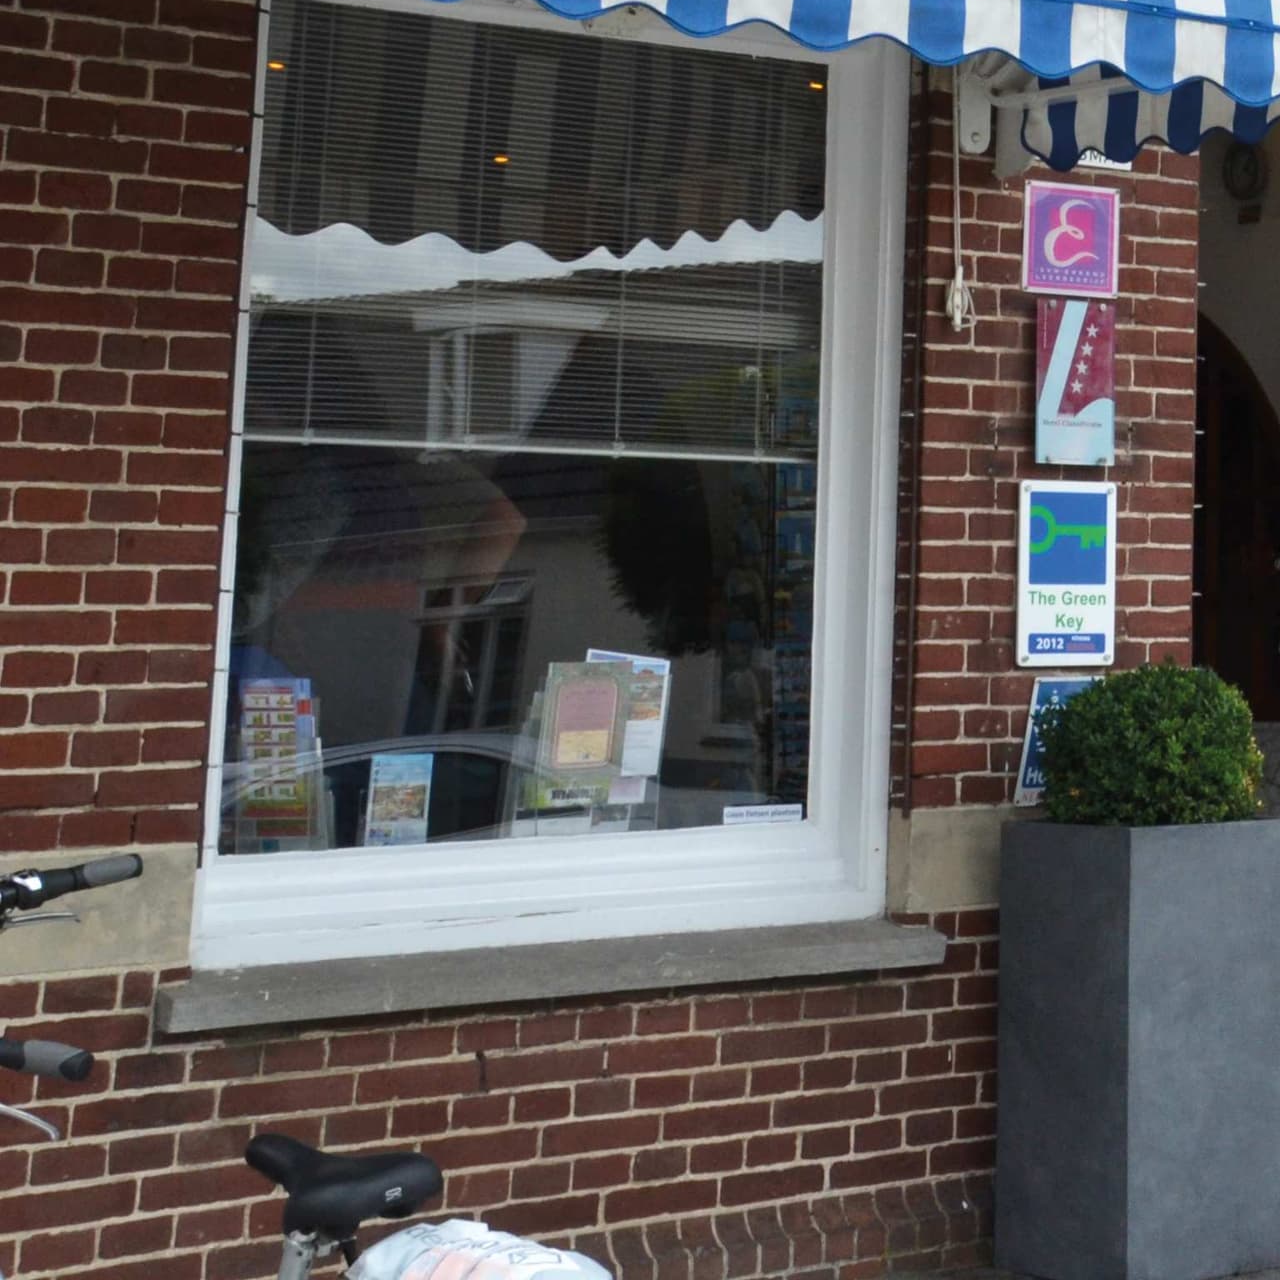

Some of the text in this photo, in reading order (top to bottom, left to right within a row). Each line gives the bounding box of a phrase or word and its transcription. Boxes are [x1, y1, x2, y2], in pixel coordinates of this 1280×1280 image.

[1028, 590, 1106, 606] The Green
[1055, 613, 1084, 632] Key
[1035, 637, 1065, 650] 2012
